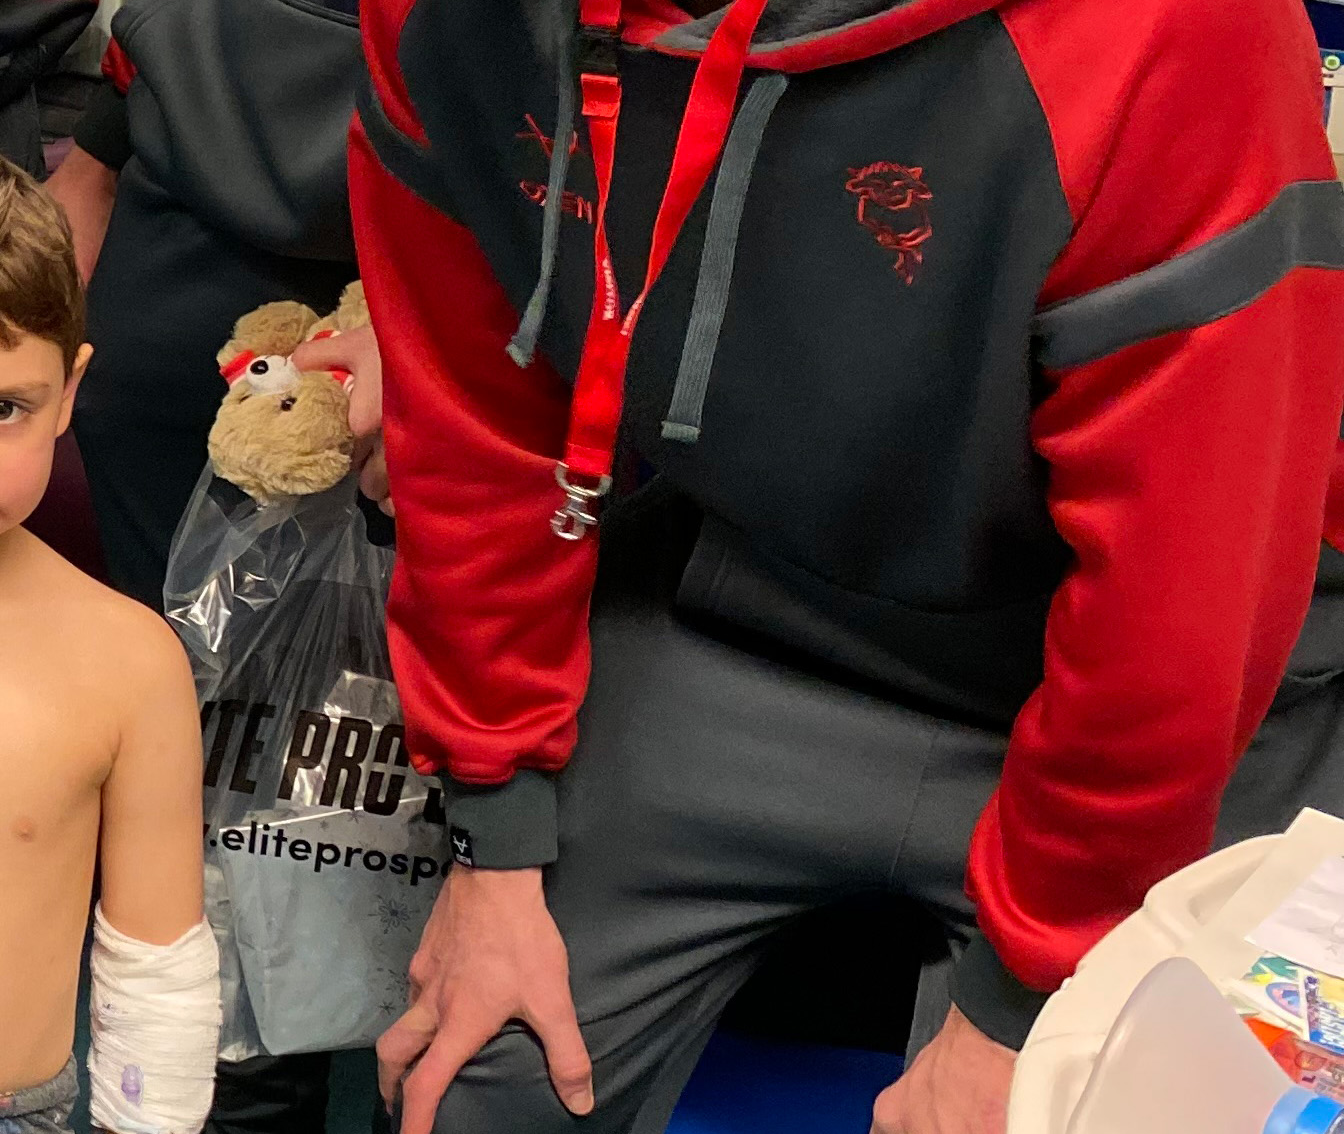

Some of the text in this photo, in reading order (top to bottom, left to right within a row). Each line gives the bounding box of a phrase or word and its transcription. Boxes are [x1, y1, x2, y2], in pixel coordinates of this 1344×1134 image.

[519, 178, 593, 225] OEN
[277, 709, 409, 817] PRO
[203, 820, 453, 886] .eliteprosp
